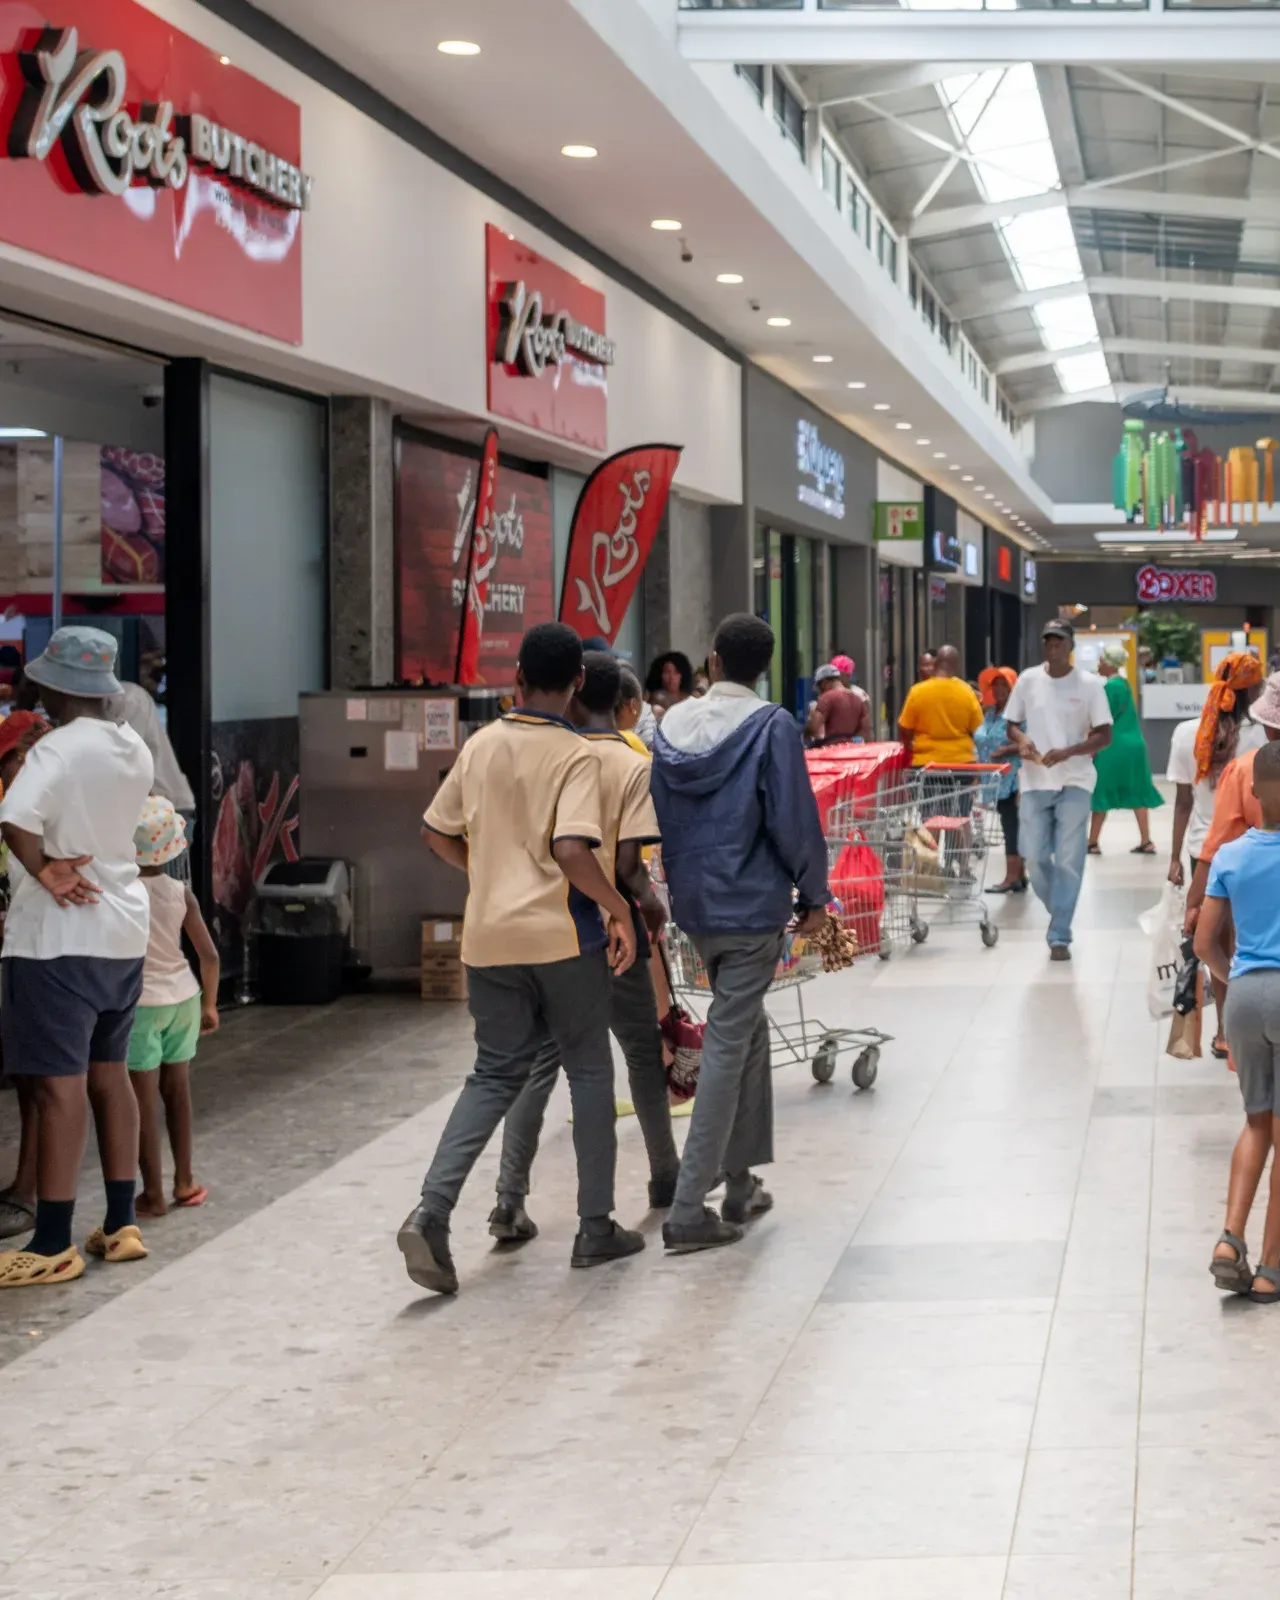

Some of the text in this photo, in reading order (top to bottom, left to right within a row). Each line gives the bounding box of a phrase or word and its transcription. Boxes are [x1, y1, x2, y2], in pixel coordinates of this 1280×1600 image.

[22, 25, 314, 210] Roots BUTCHERY
[573, 468, 651, 635] Roots
[1138, 566, 1217, 600] BOXER
